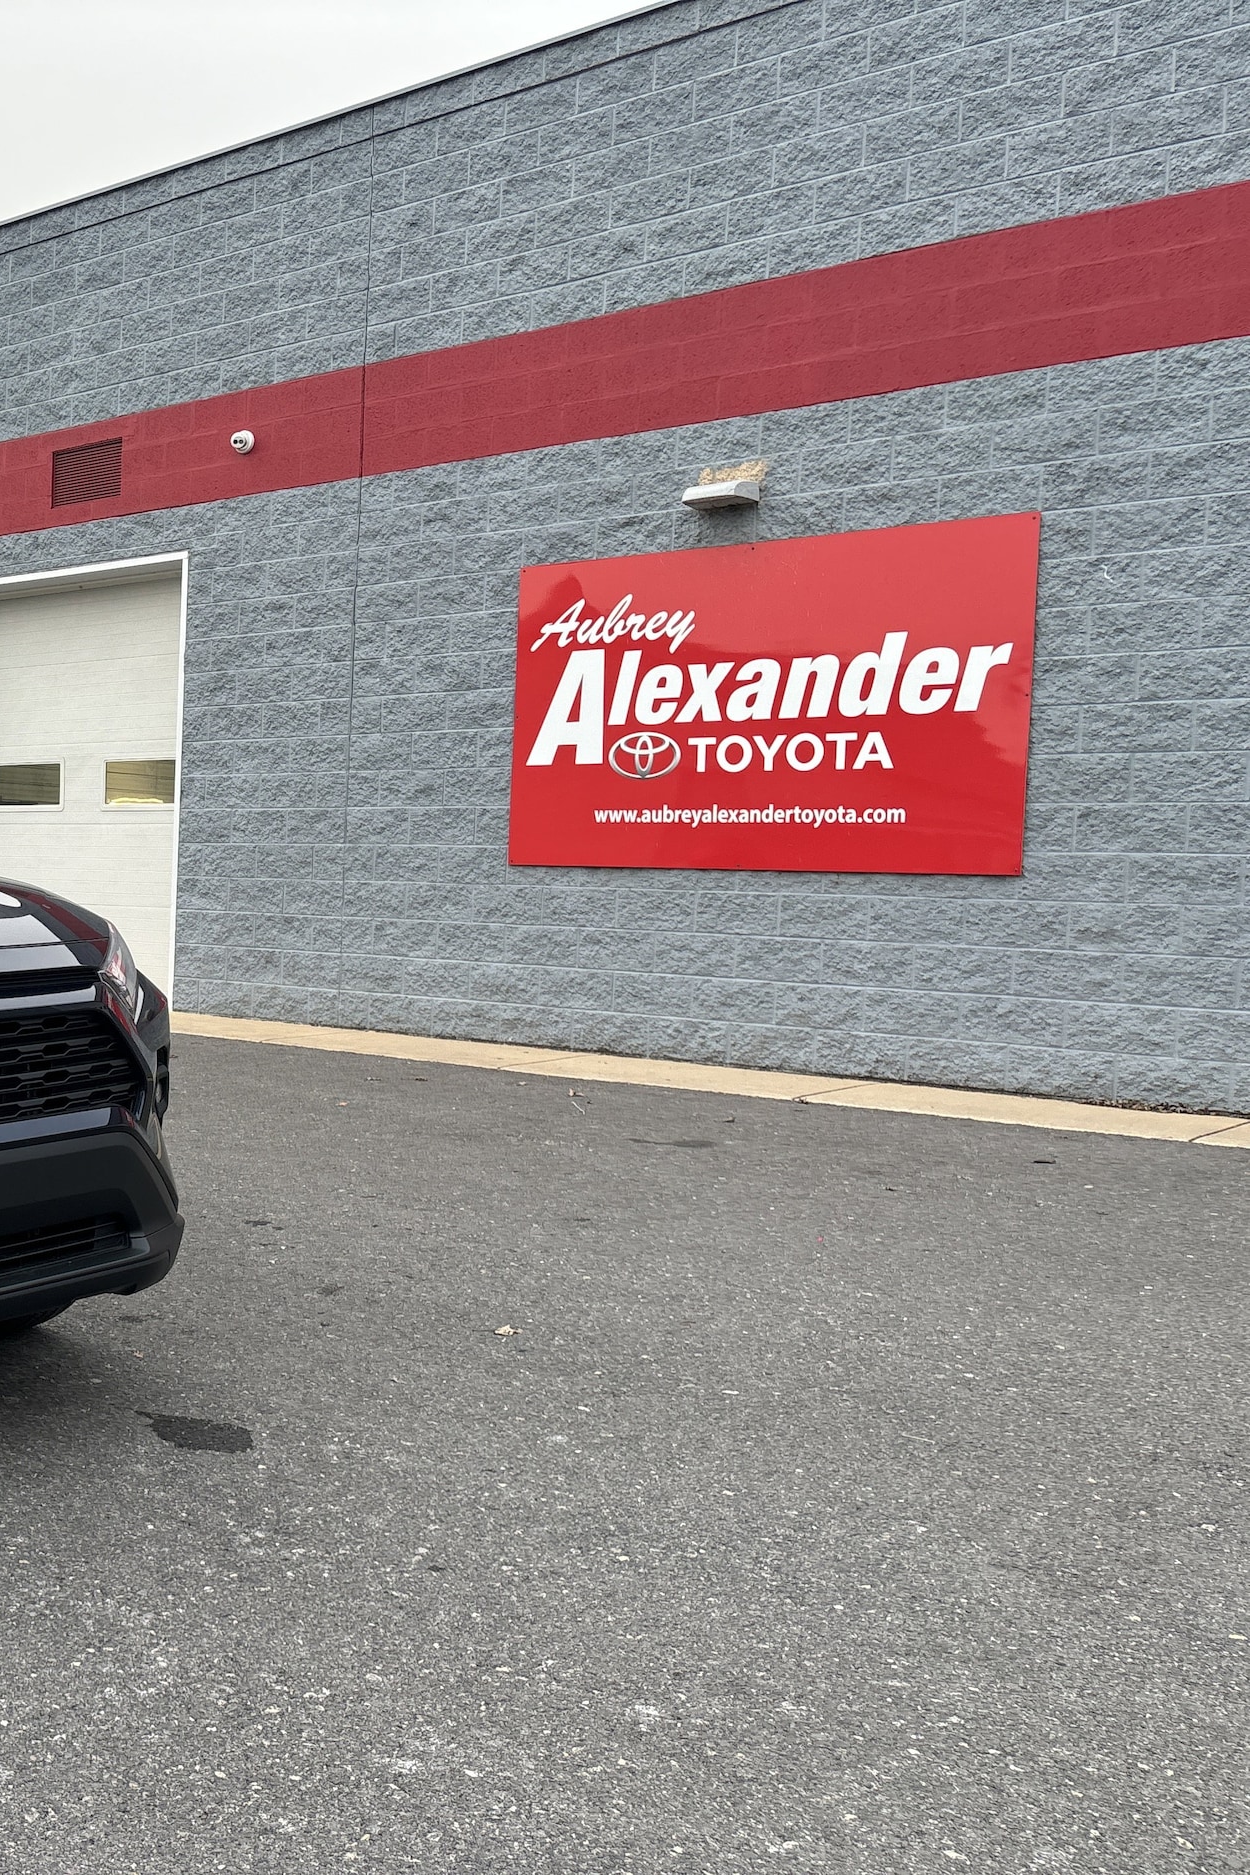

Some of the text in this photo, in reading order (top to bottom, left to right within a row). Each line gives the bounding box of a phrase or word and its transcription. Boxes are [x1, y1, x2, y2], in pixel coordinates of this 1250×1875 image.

[530, 594, 695, 654] Aubrey
[526, 631, 1014, 767] Alexander
[688, 731, 894, 773] TOYOTA
[593, 804, 906, 829] www.aubreyalexandertoyota.com
